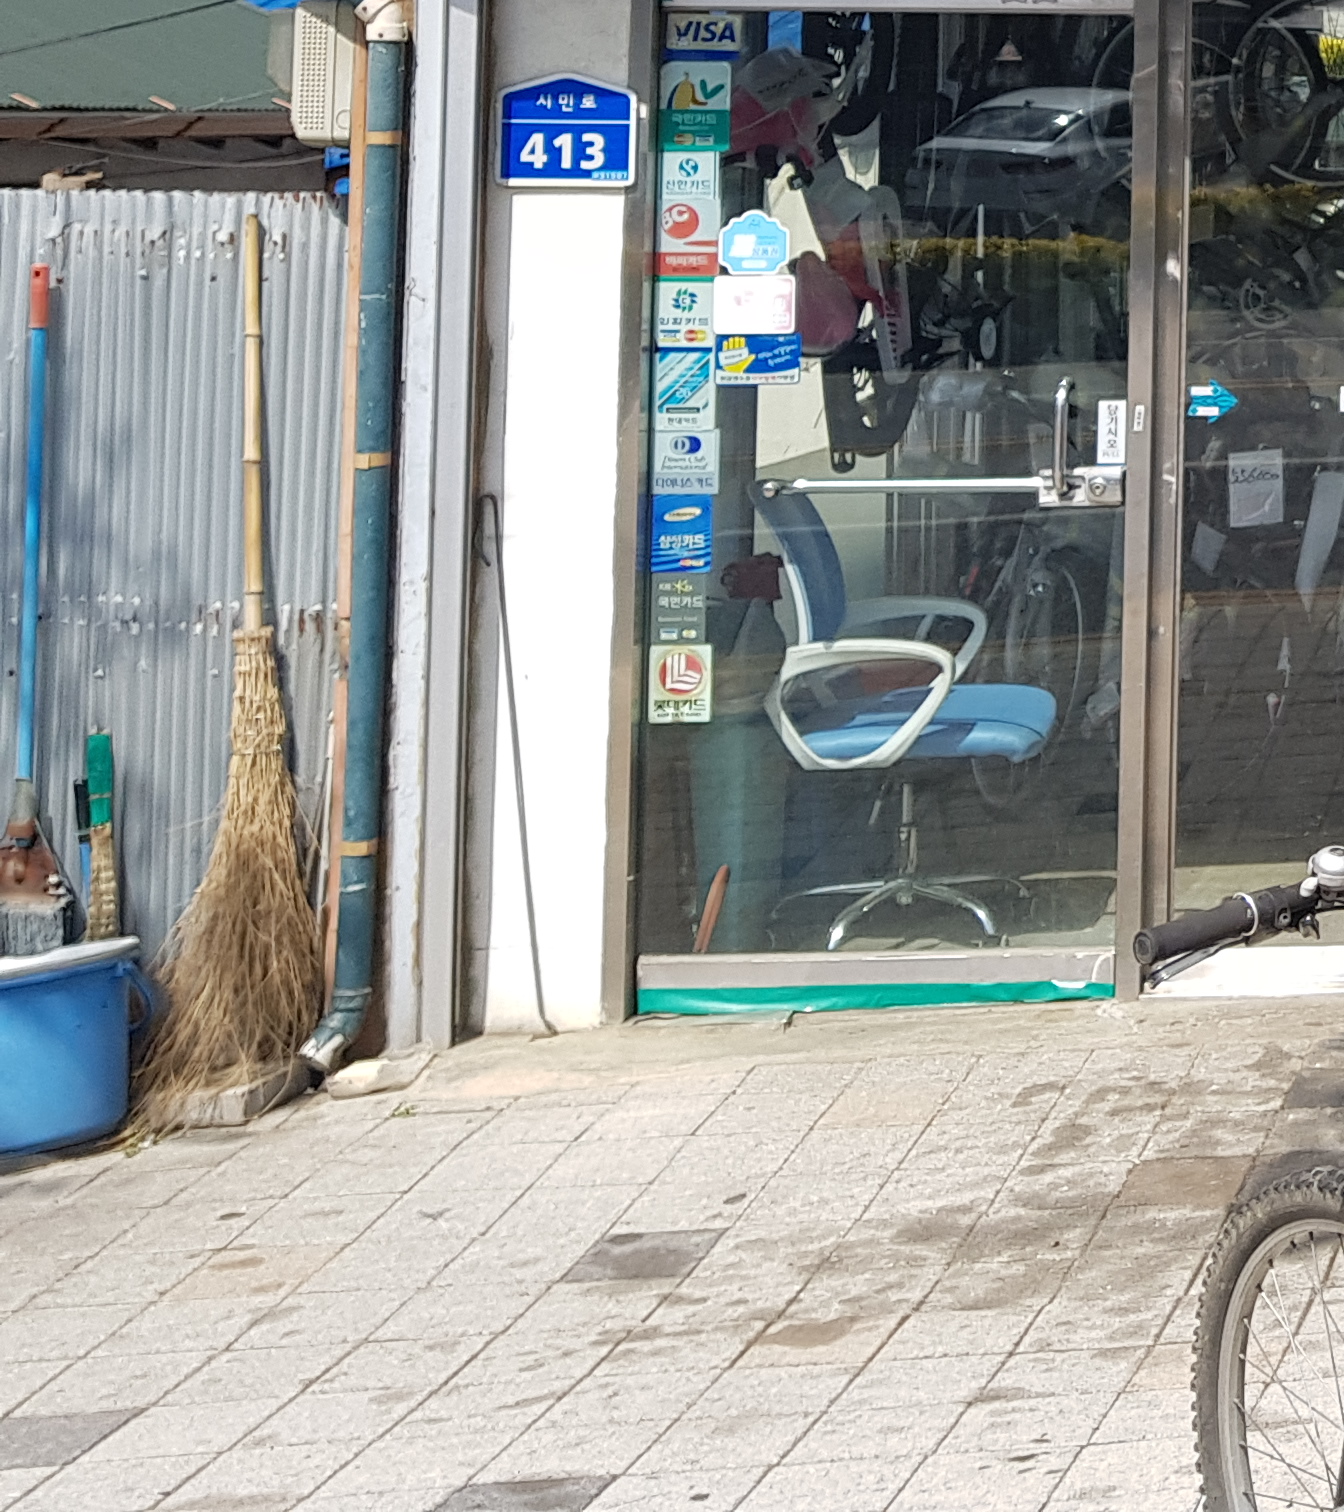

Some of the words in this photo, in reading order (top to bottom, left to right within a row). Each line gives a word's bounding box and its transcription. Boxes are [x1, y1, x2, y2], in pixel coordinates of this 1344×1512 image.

[675, 21, 736, 42] VISA
[536, 93, 597, 112] 시민로
[520, 133, 605, 170] 413
[662, 206, 690, 230] BC
[1107, 404, 1118, 449] 당기시오
